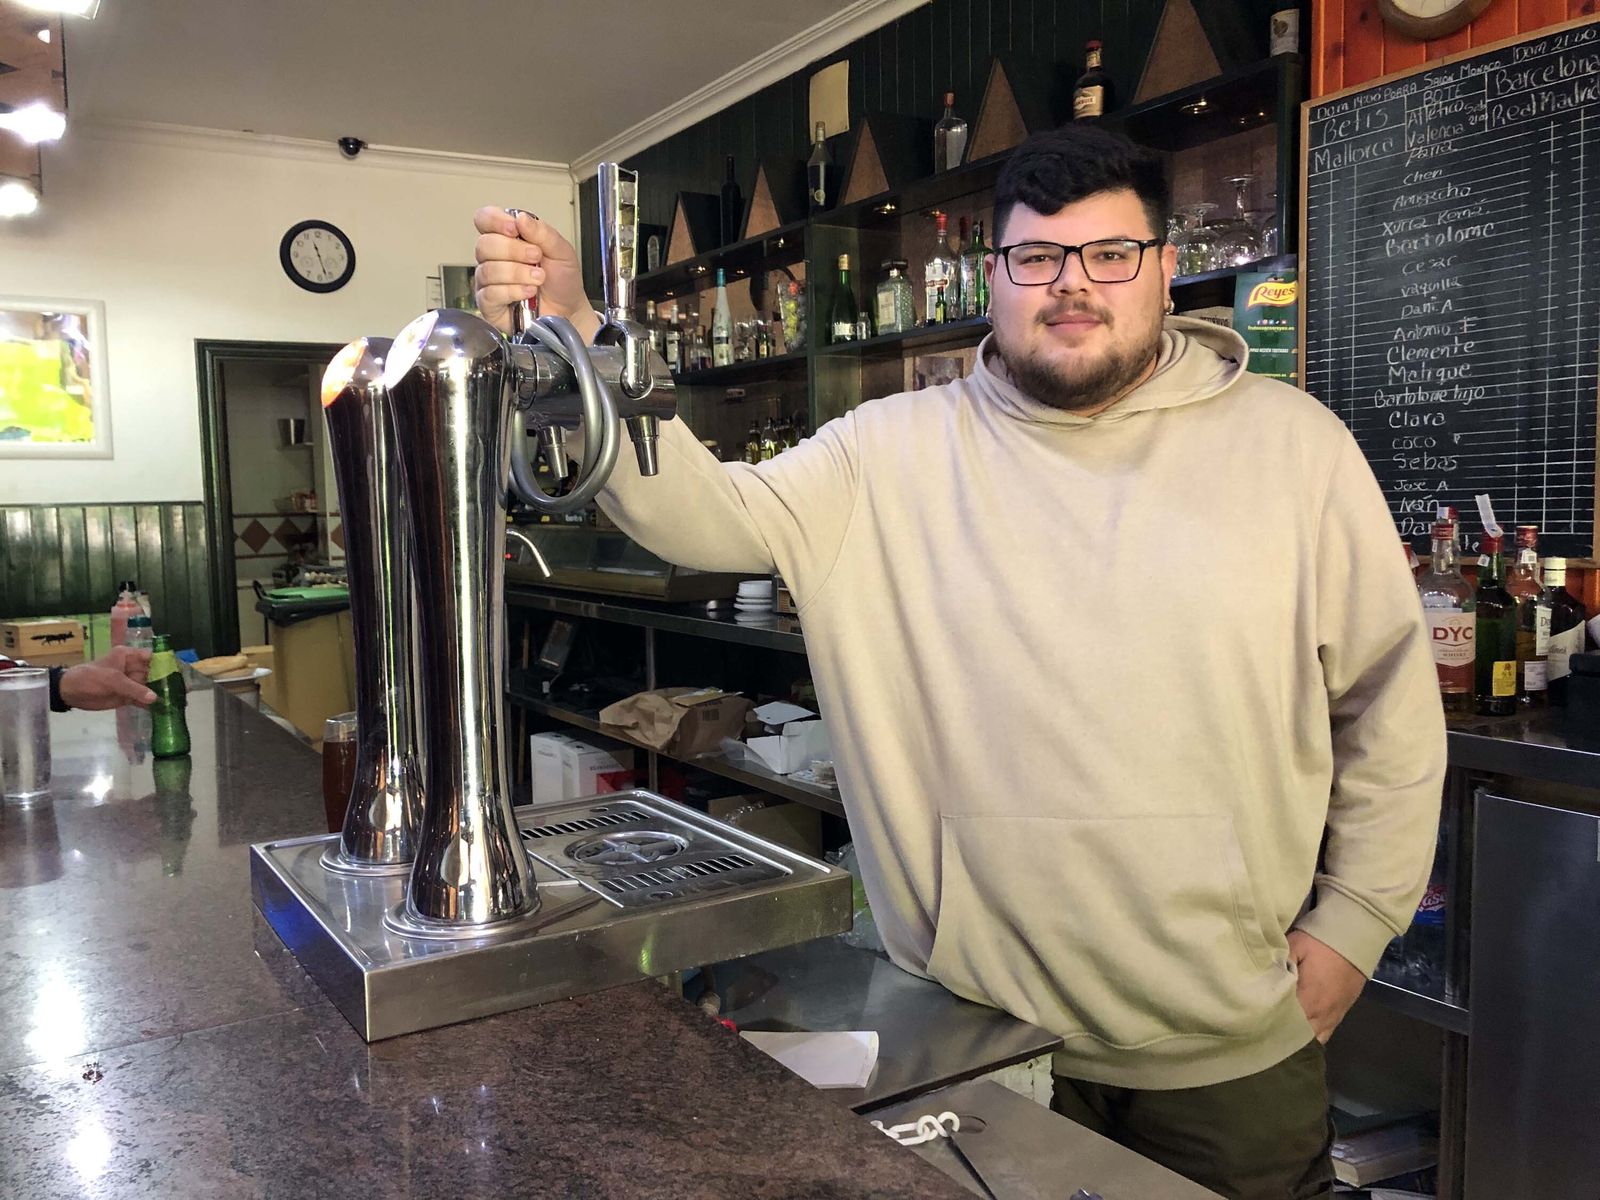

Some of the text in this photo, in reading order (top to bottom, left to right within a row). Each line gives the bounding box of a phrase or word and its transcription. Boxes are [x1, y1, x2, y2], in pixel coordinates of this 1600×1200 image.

[1495, 54, 1600, 95] Barcelona
[1423, 82, 1466, 106] BOTE
[1492, 77, 1600, 127] Real Madrid
[1323, 107, 1389, 145] Betis
[1407, 123, 1464, 147] Valencia
[1315, 138, 1393, 172] Mallorca
[1254, 285, 1296, 301] Reyes
[1440, 299, 1452, 314] A
[1394, 324, 1450, 341] Antonio
[1387, 336, 1475, 364] Clemente
[1453, 384, 1485, 405] hijo
[1389, 410, 1446, 428] Clara
[1392, 451, 1457, 472] Sebas
[1436, 480, 1448, 492] A
[1400, 494, 1440, 512] Iván
[1432, 626, 1473, 641] DYC
